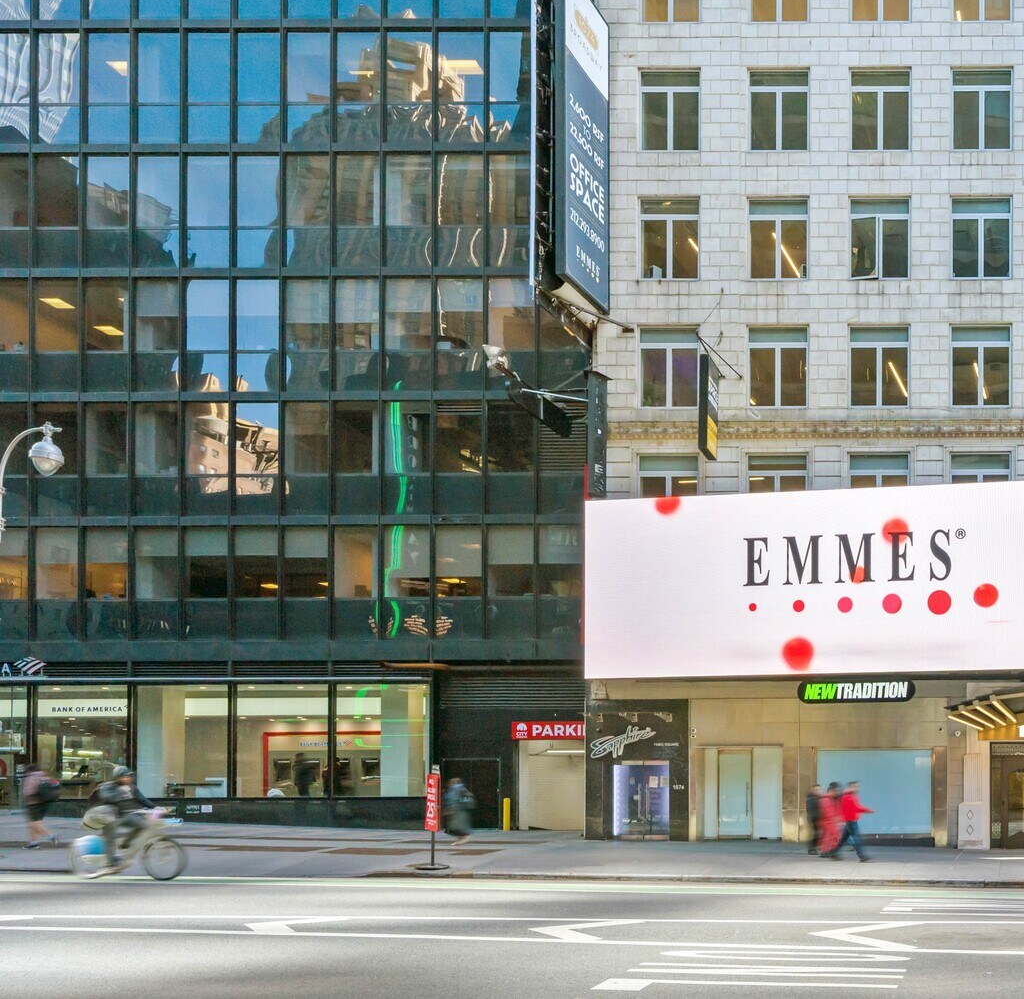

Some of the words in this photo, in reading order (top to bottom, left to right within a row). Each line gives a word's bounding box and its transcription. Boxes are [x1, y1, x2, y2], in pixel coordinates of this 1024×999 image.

[583, 124, 592, 141] TO
[569, 153, 605, 204] OFFICE
[569, 172, 605, 225] SPACE
